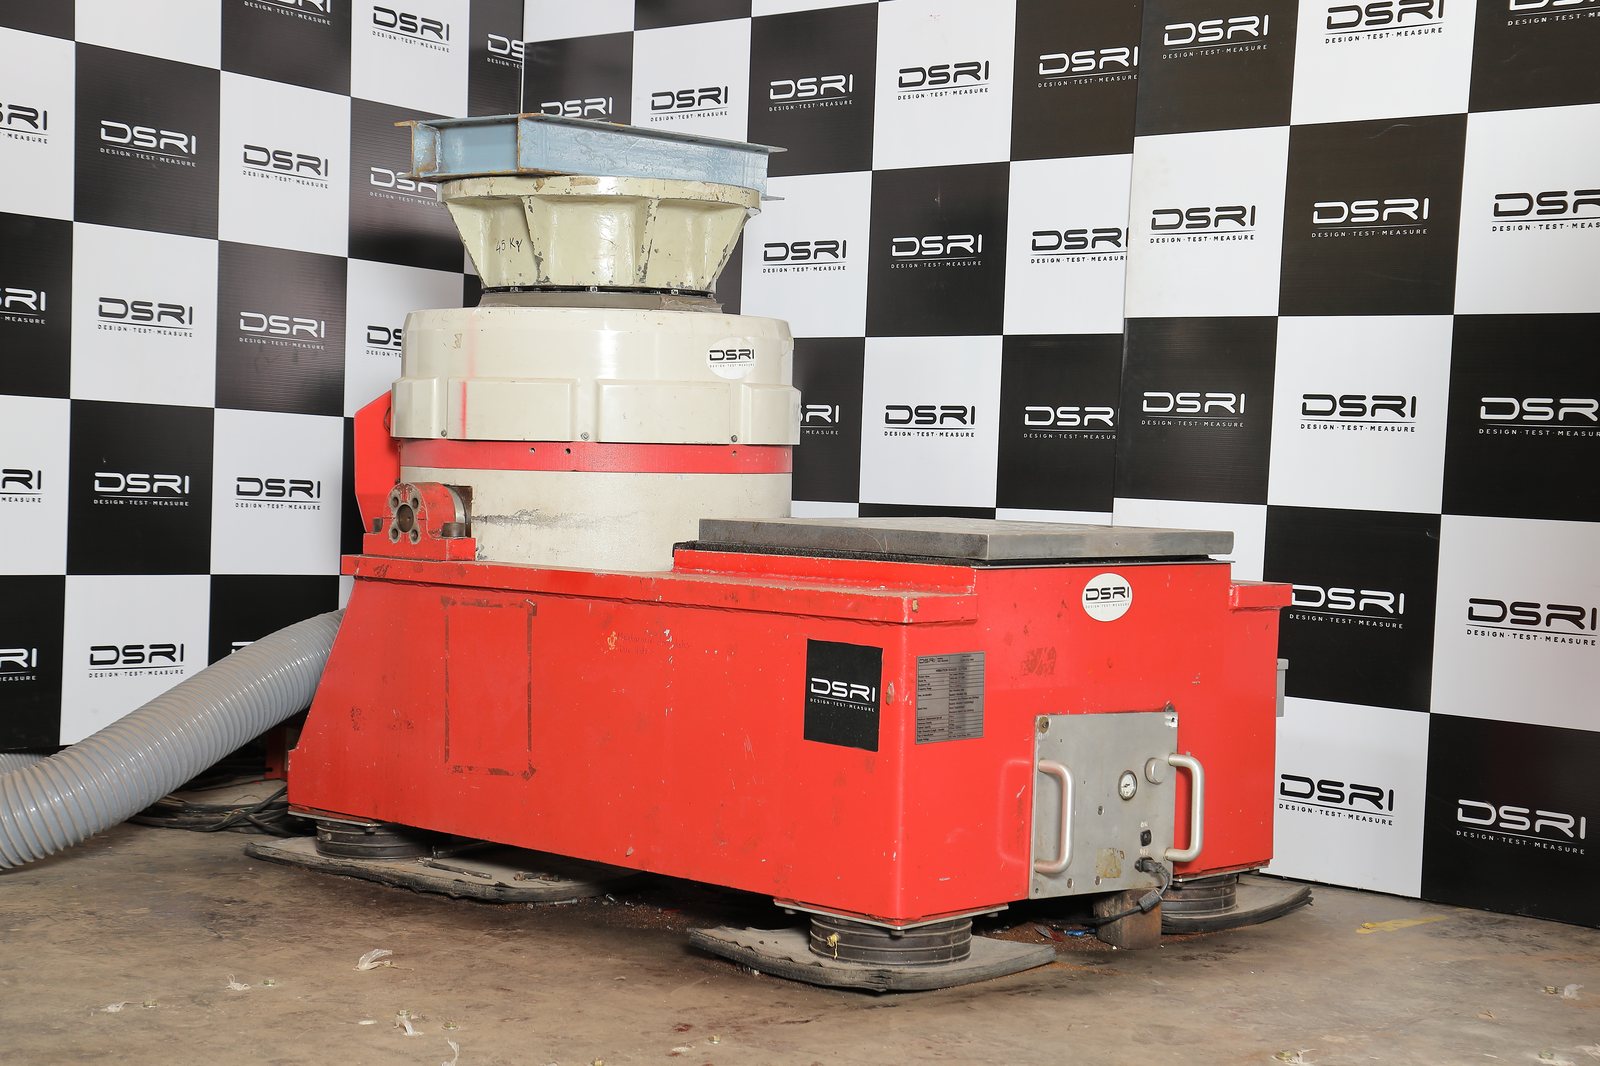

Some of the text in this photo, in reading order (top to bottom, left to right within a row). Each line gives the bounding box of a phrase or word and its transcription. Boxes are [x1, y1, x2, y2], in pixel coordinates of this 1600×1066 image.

[373, 6, 450, 41] DSRI
[1326, 0, 1444, 30] DSRI
[1164, 14, 1269, 46] DSRI
[488, 33, 524, 60] DS
[1038, 46, 1138, 75] DSRI
[898, 60, 990, 88] DSRI
[651, 86, 728, 111] DSRI
[770, 74, 853, 100] DSRI
[0, 104, 48, 131] RI
[540, 96, 612, 118] DSRI
[100, 120, 196, 154] DSRI
[243, 144, 328, 177] DSRI
[1312, 198, 1429, 224] DSRI
[1493, 190, 1600, 217] DSR
[1151, 205, 1256, 230] DSRI
[1571, 221, 1600, 229] MEAS
[763, 240, 847, 262] DSRI
[892, 234, 982, 256] DSRI
[0, 287, 46, 312] RI
[98, 297, 193, 325] DSRI
[240, 312, 325, 338] DSRI
[709, 348, 754, 361] DSRI
[800, 404, 840, 423] RI
[884, 405, 976, 425] DSRI
[1142, 392, 1245, 414] DSRI
[1301, 394, 1417, 418] DSRI
[1480, 397, 1599, 422] DSR
[1024, 406, 1114, 427] DSR
[2, 468, 42, 490] RI
[94, 472, 190, 494] DSRI
[236, 477, 321, 499] DSRI
[1086, 586, 1130, 601] DSRI
[1290, 584, 1405, 615] DSRI
[1468, 598, 1597, 631] DSRI
[0, 648, 37, 668] RI
[89, 643, 184, 666] DSRI
[810, 677, 876, 702] DSRI
[1280, 774, 1394, 812] DSRI
[1457, 799, 1586, 840] DSRI
